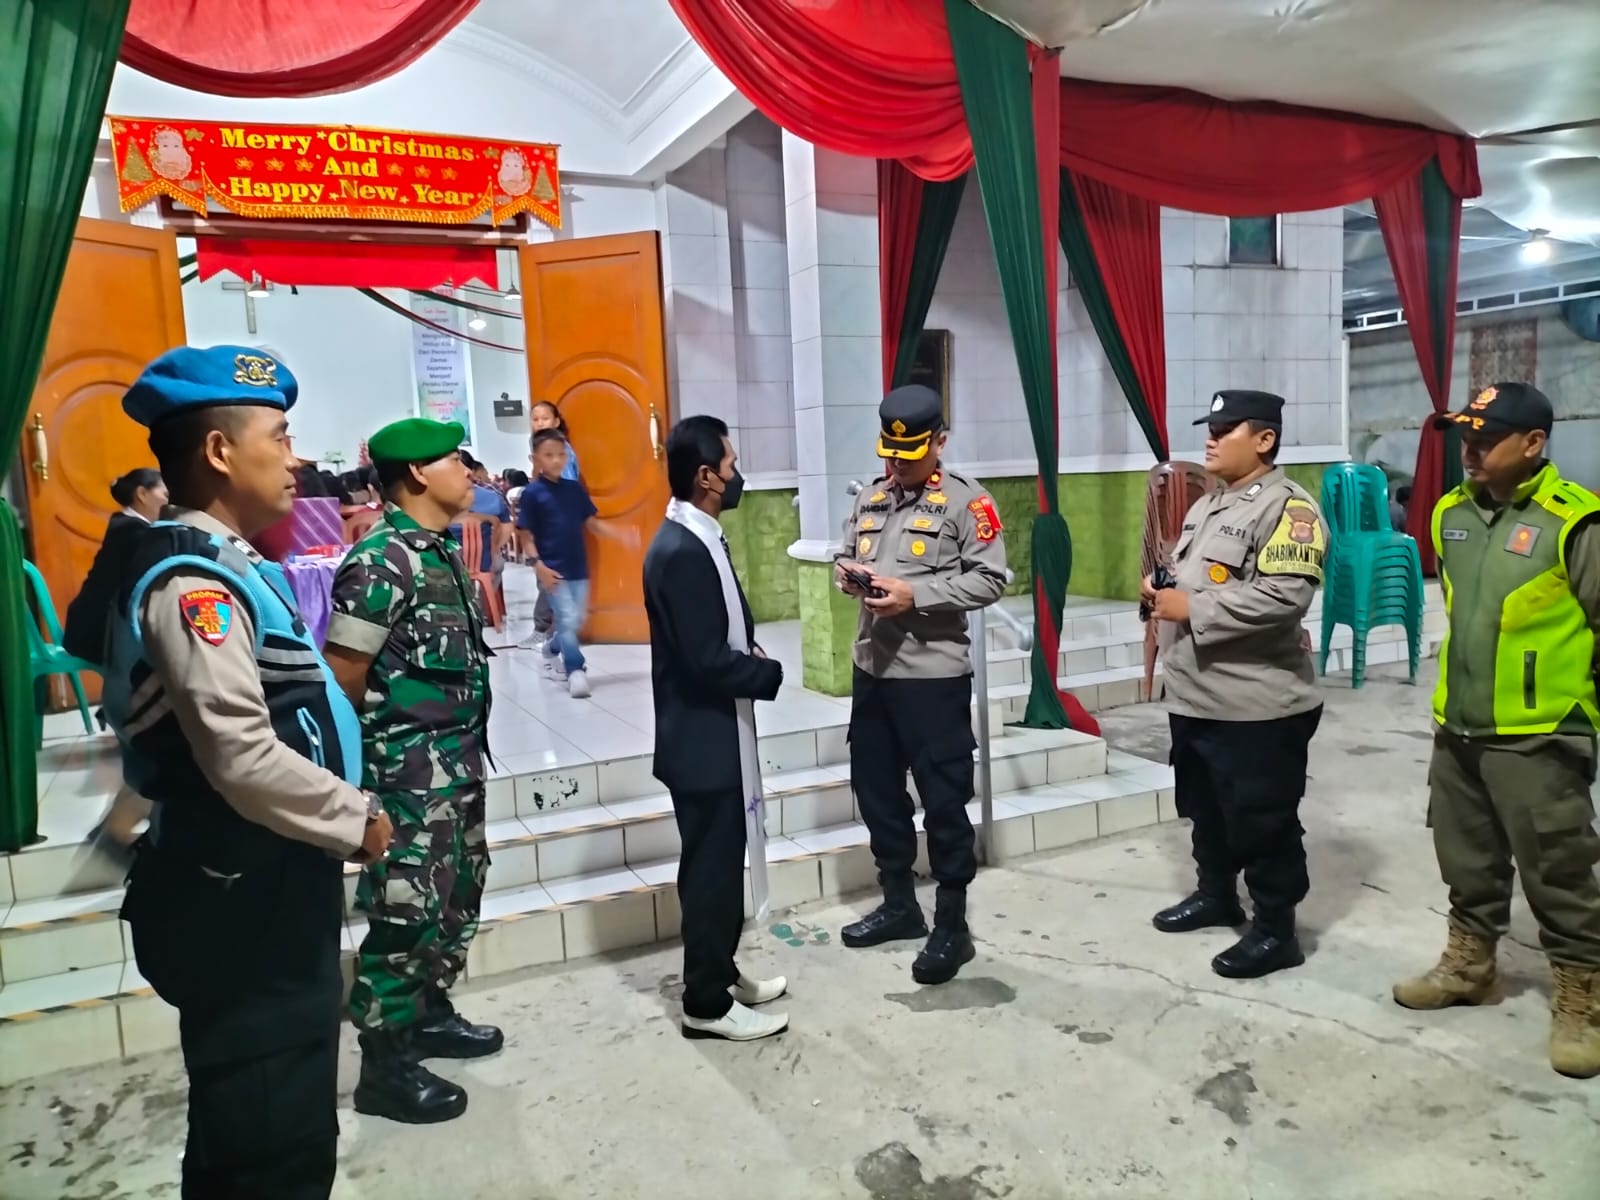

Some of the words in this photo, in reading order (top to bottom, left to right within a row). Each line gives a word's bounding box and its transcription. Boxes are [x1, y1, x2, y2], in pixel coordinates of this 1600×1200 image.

[219, 128, 312, 155] Merry
[328, 131, 475, 161] Christmas
[322, 156, 379, 177] And
[228, 177, 324, 203] Happy
[339, 179, 399, 201] New
[411, 184, 475, 206] Year
[913, 504, 948, 515] POLRI
[1219, 525, 1246, 539] POLRI
[186, 591, 224, 600] PROPAM
